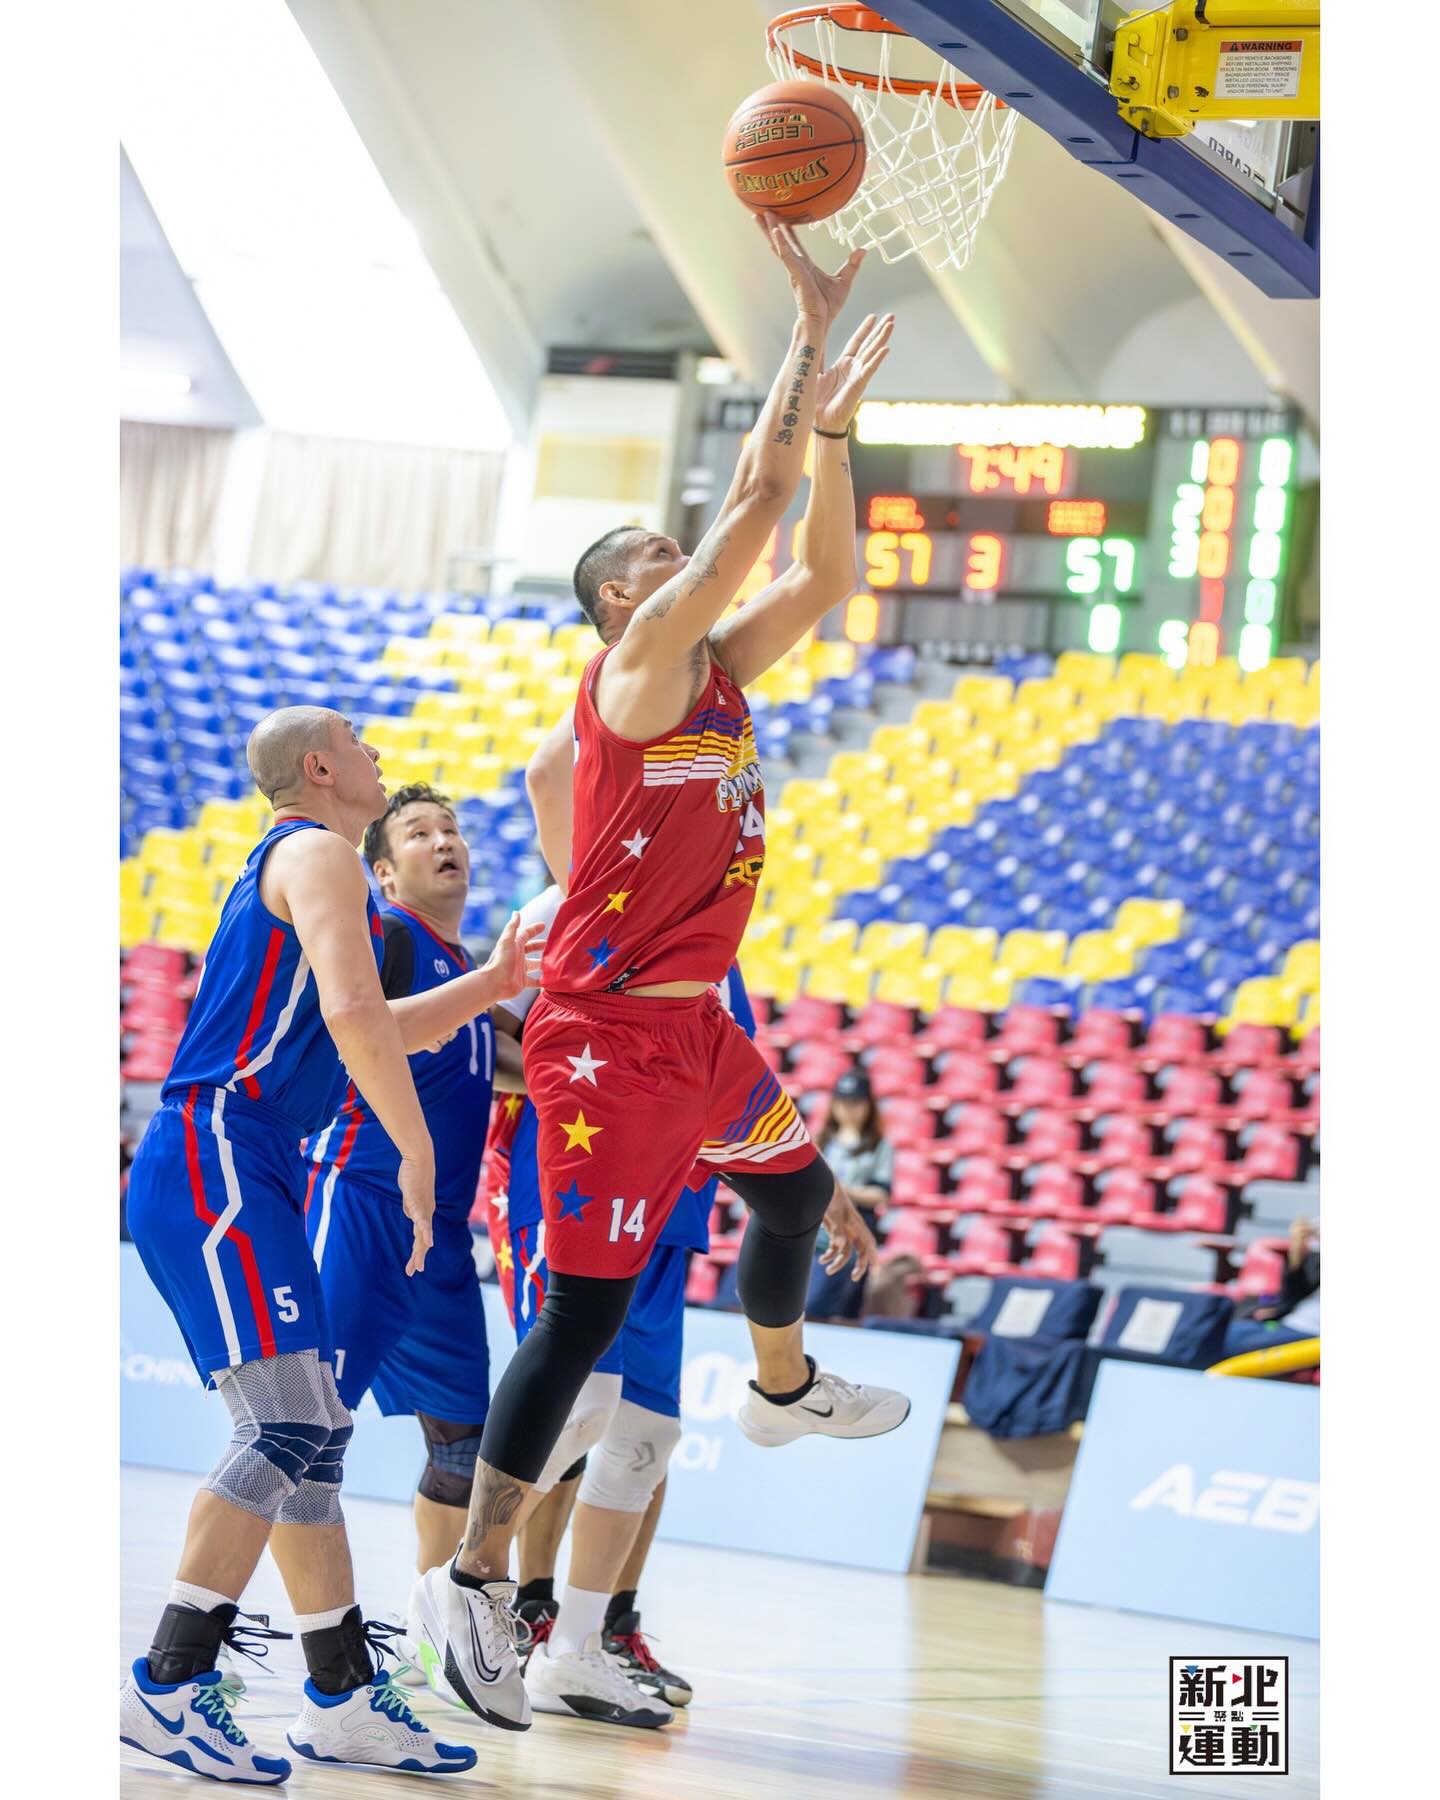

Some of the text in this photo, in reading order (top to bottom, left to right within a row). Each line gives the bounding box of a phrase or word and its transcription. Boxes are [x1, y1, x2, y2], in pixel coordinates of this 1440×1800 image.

[1240, 42, 1292, 51] WARNING
[735, 125, 814, 153] LEGACY
[735, 155, 829, 192] SPALDING
[957, 445, 1064, 494] 7:49
[865, 531, 932, 587] 57
[966, 535, 1002, 590] 3
[1066, 537, 1135, 593] 57
[608, 1198, 647, 1242] 14
[272, 1285, 300, 1323] 5
